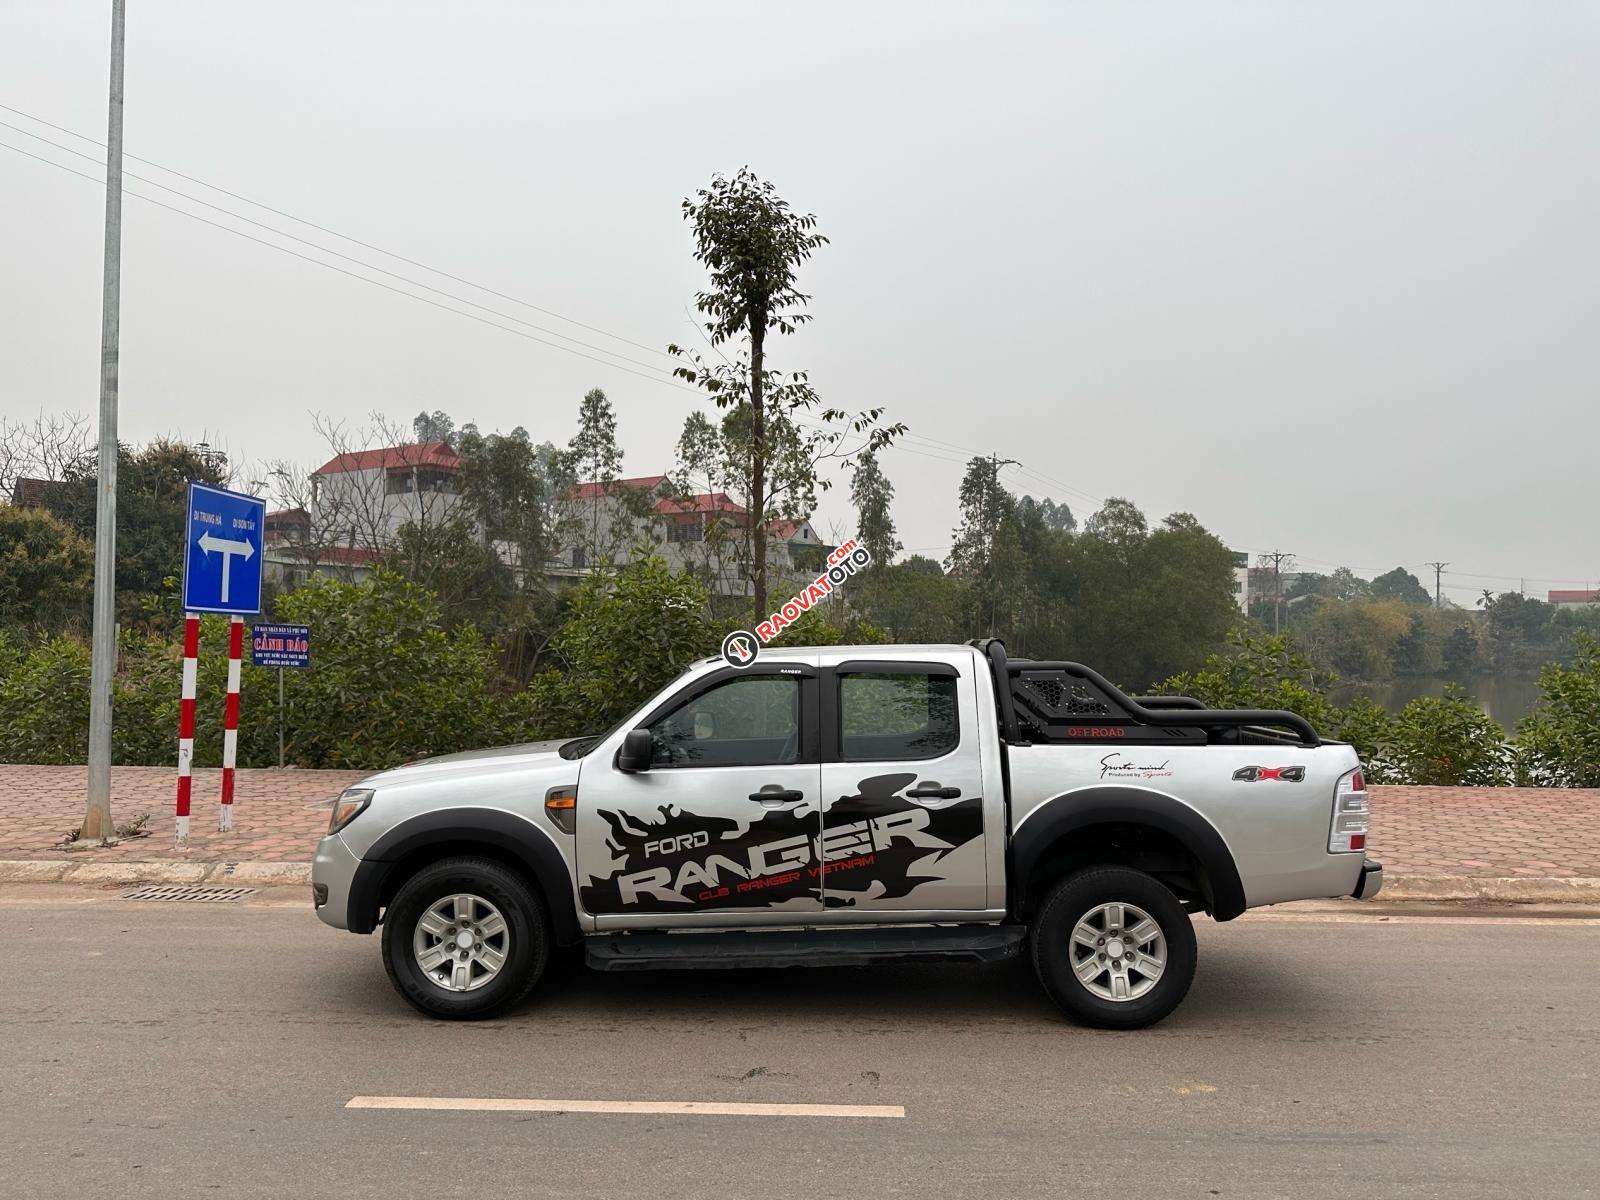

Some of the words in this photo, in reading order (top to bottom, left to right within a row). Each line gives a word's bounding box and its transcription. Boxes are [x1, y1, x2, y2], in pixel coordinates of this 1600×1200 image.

[200, 511, 215, 525] TRUNG
[254, 633, 284, 651] CẢNH
[286, 637, 308, 652] BÁO
[618, 808, 957, 905] RANGER
[643, 830, 709, 859] FORD
[737, 872, 801, 894] RANGER
[807, 855, 875, 878] VIETNAM
